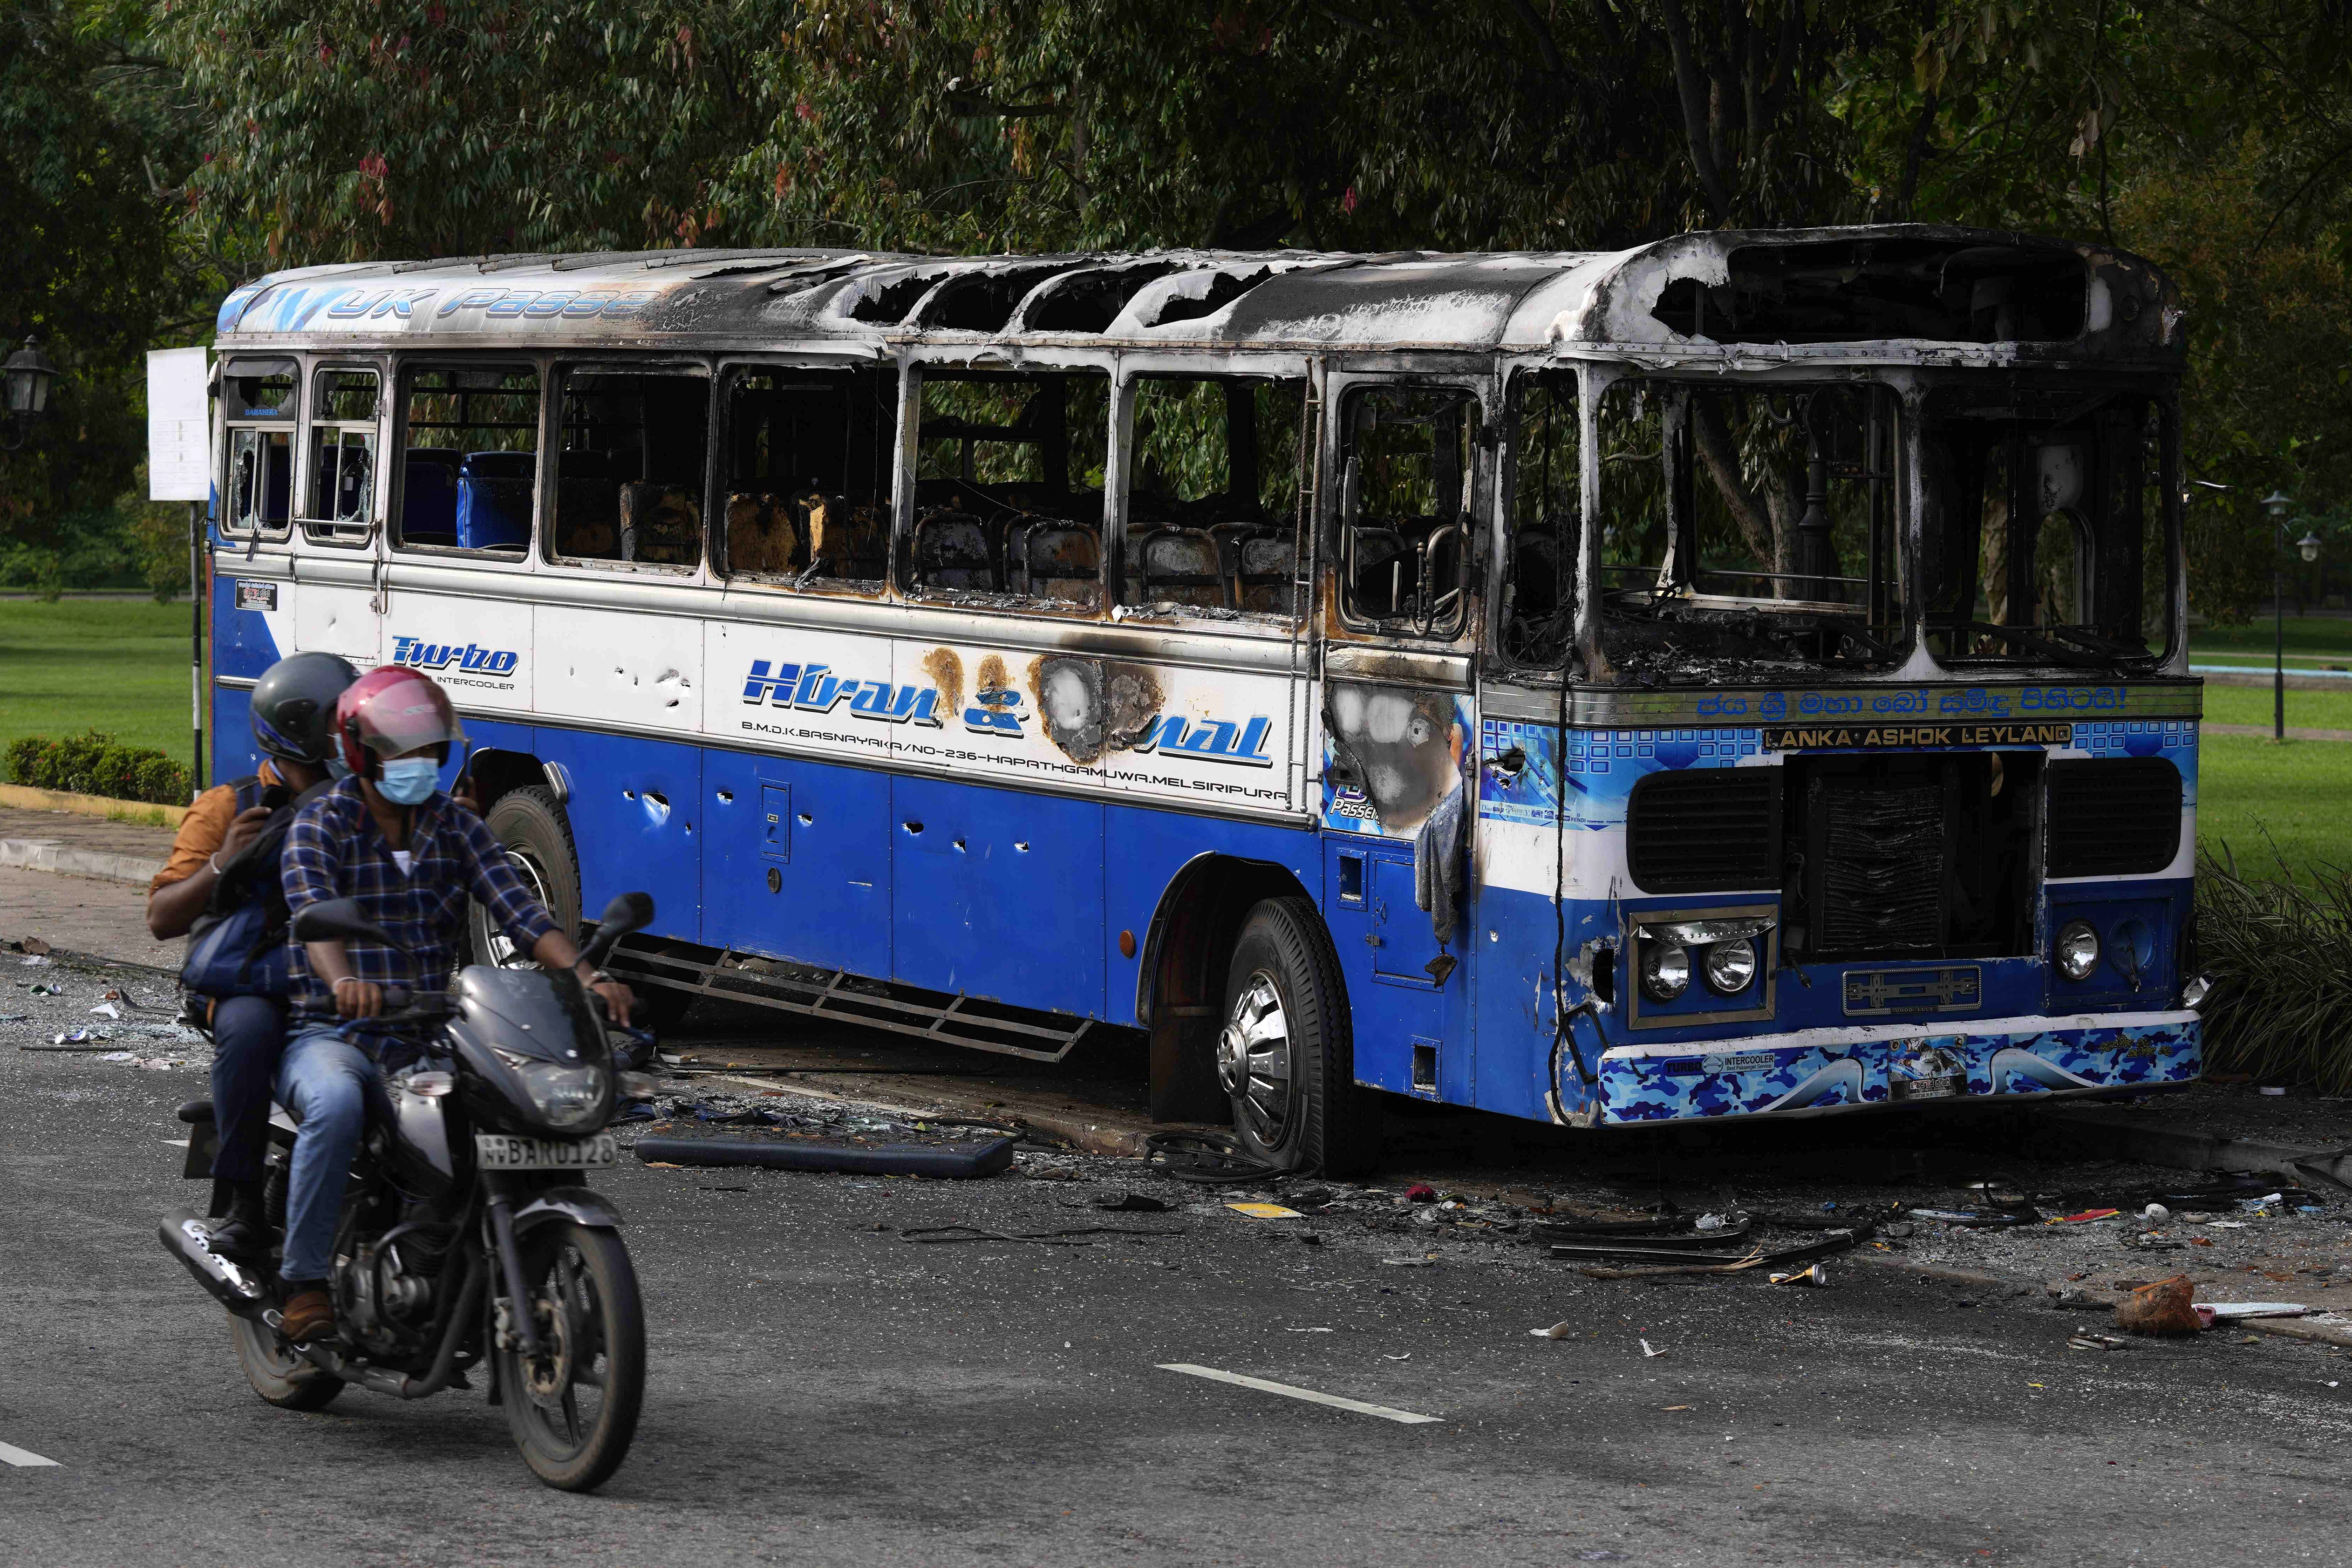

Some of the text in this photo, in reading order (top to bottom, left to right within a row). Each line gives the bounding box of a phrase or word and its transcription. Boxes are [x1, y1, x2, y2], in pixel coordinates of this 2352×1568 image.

[327, 288, 438, 319] UK
[392, 635, 519, 677] Turbo
[437, 676, 514, 690] INTERCOOLER
[1696, 694, 1748, 716] ජය
[1799, 692, 1862, 714] මහා
[1765, 727, 2071, 747] LANKA ASHOK LEYLAND
[1725, 1055, 1774, 1065] INTERCOOLER
